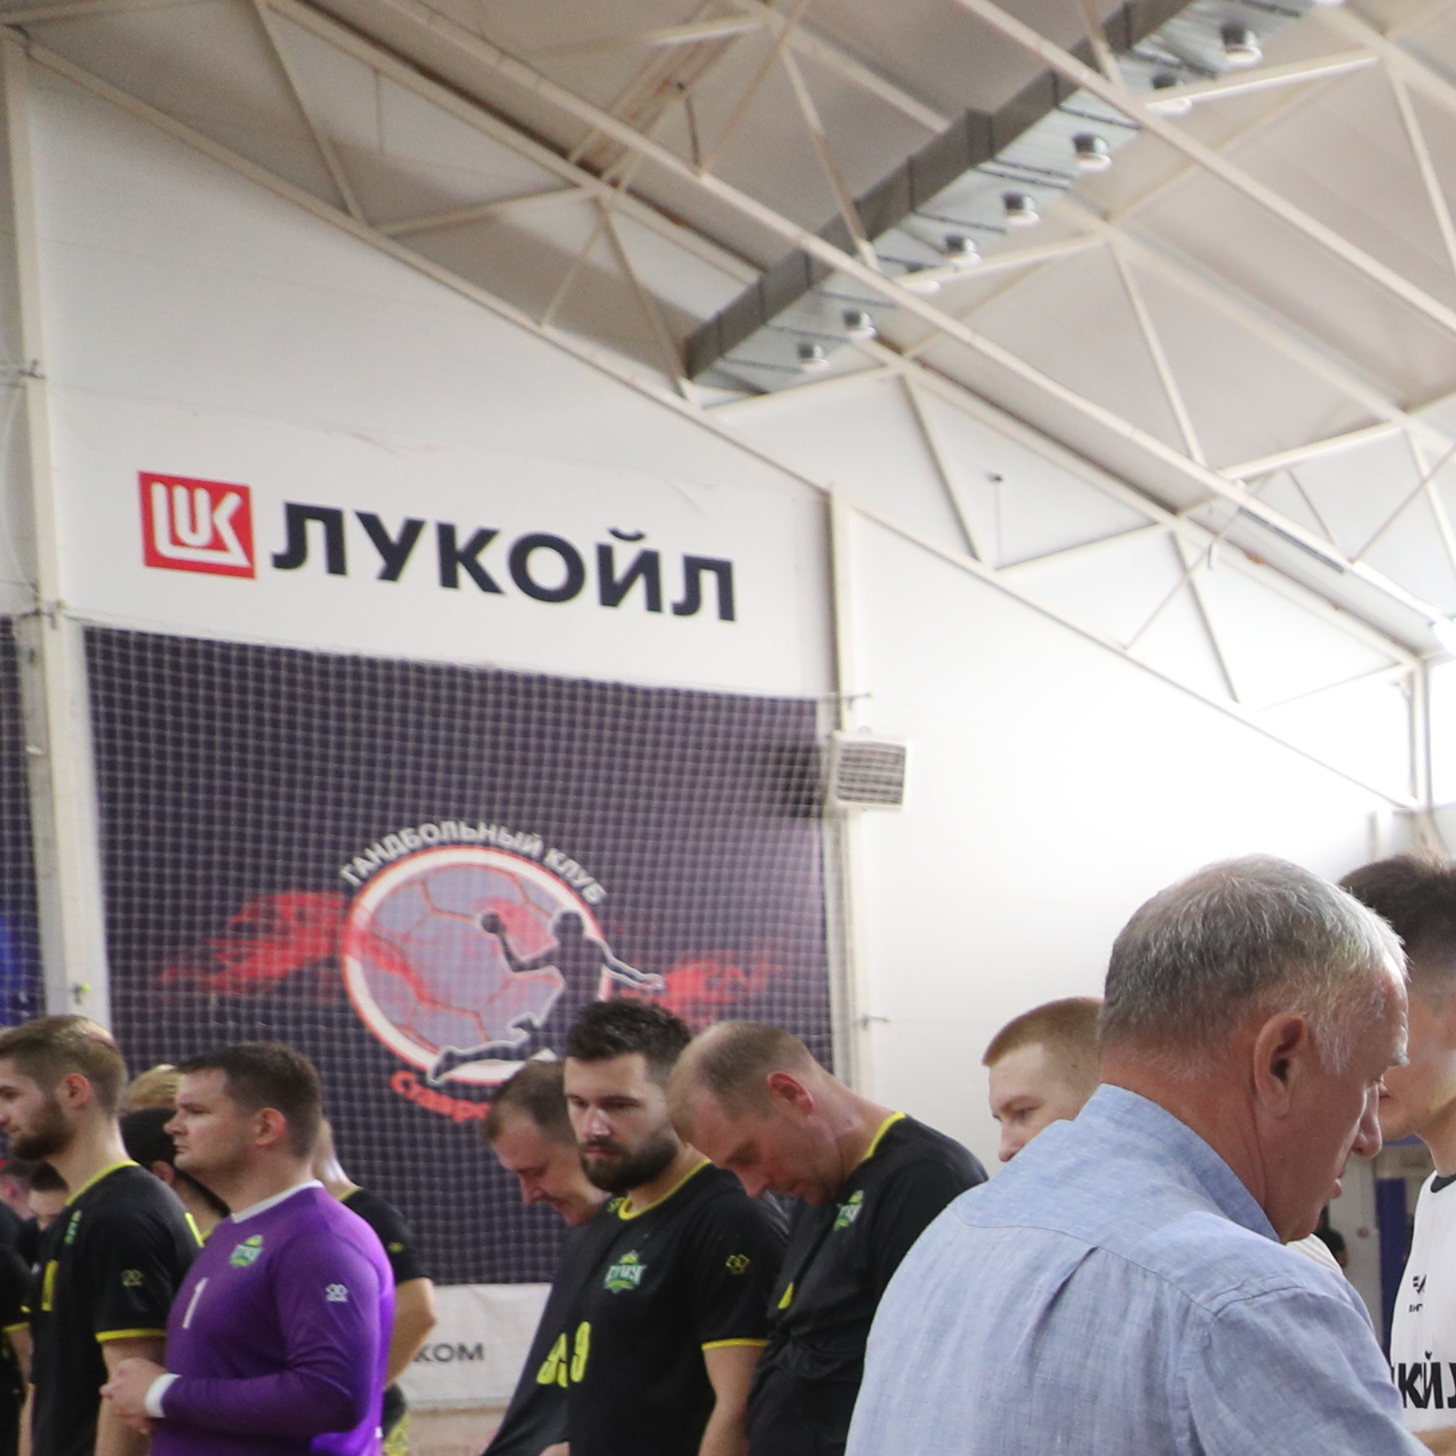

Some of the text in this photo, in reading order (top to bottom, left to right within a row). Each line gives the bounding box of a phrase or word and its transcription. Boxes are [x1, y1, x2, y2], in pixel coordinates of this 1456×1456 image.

[272, 502, 736, 622] ЛУКОЙЛ
[340, 820, 607, 905] ГАНДБОЛЬНЫЙ КЛУБ
[182, 1277, 208, 1329] 1
